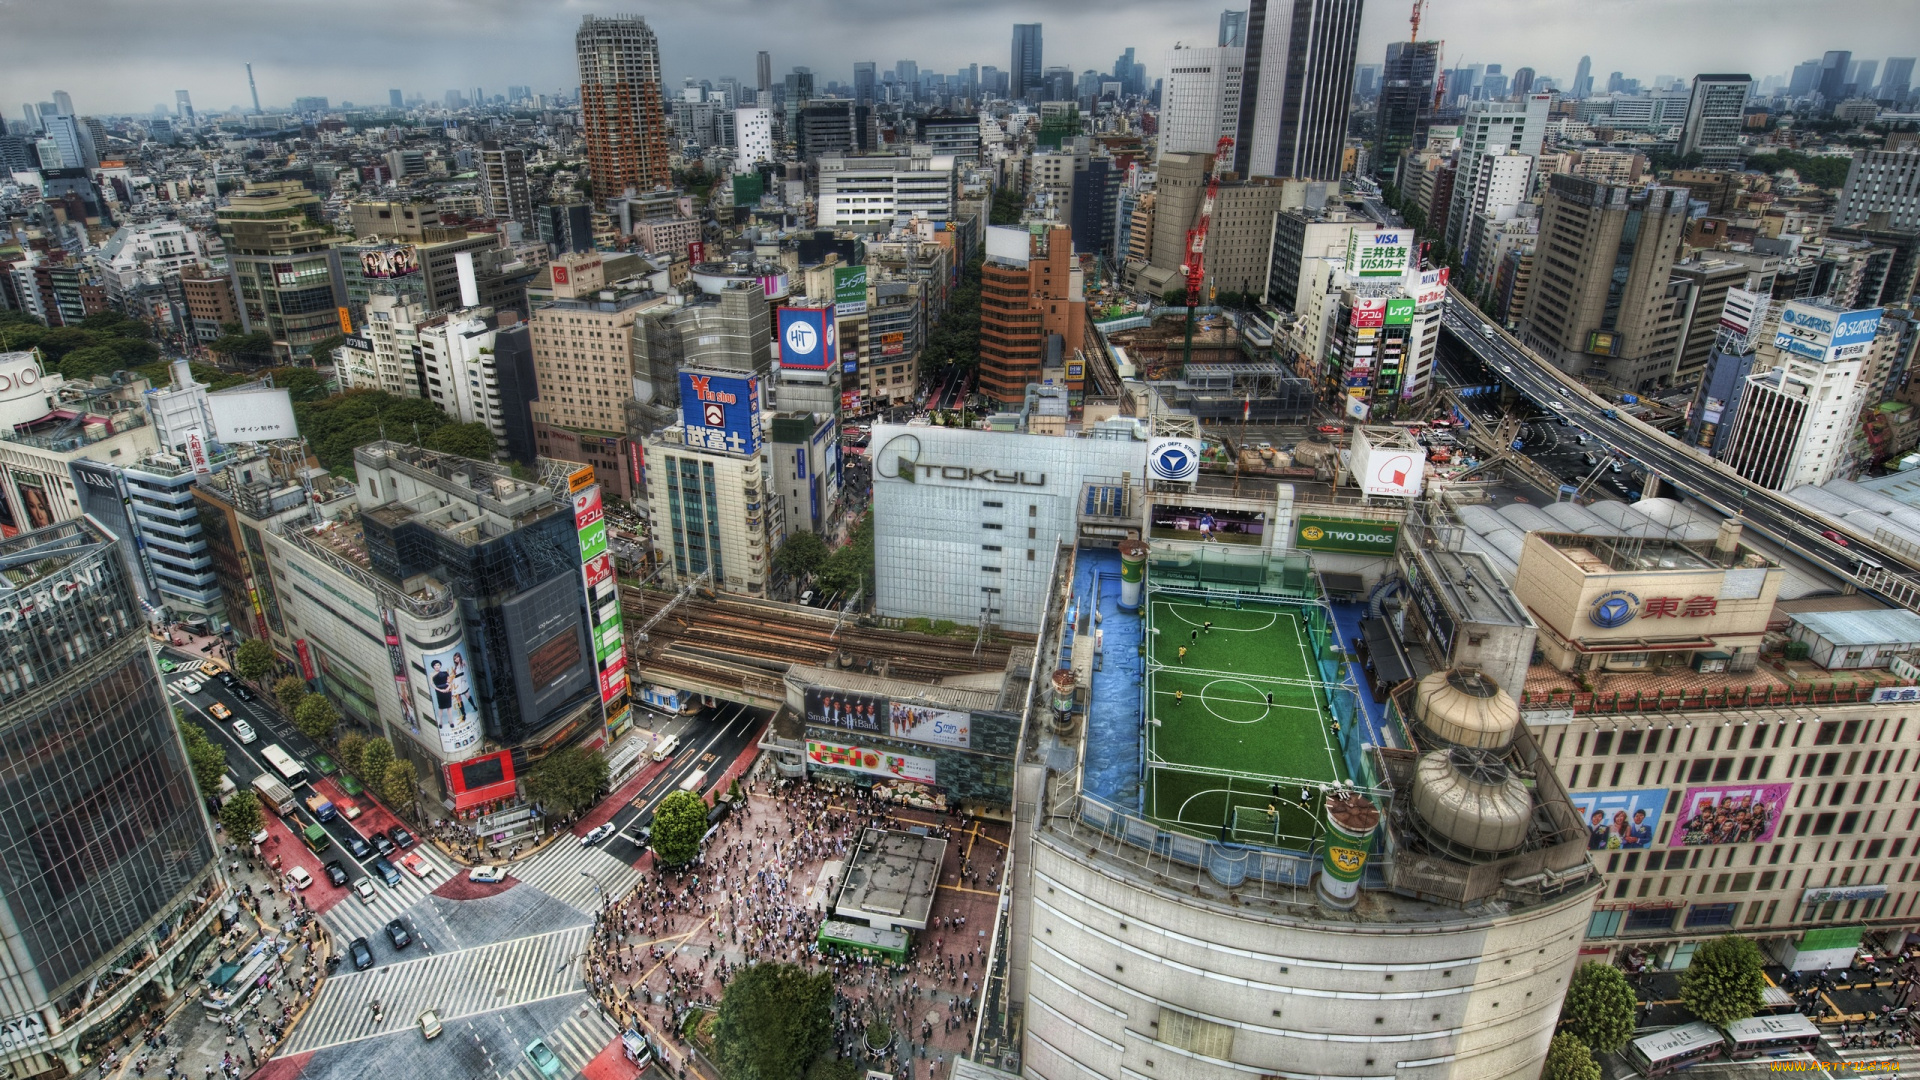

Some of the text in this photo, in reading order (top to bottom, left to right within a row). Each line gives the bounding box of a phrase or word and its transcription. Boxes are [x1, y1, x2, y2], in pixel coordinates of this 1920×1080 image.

[1375, 234, 1398, 244] VISA
[1362, 246, 1407, 258] 三井住友
[1360, 259, 1406, 268] VISAカード
[1390, 306, 1412, 316] レイク
[1846, 318, 1878, 336] STARTS
[1790, 328, 1818, 340] スターツ
[234, 424, 280, 434] デザイン制作中
[686, 424, 746, 454] 武富士
[188, 434, 206, 466] 大和証券
[1151, 443, 1166, 456] TOKYU
[1184, 444, 1198, 458] STORE
[77, 470, 115, 488] ZARA
[572, 475, 593, 488] プロミス
[916, 464, 1045, 486] TOKYU
[1368, 486, 1417, 494] TOKYU
[580, 508, 602, 526] アコム
[582, 531, 604, 552] レイク
[1325, 530, 1394, 544] TWO DOGS
[1640, 596, 1718, 620] 東急
[1876, 690, 1917, 702] 東急
[808, 712, 830, 722] Smap
[934, 721, 943, 734] 5
